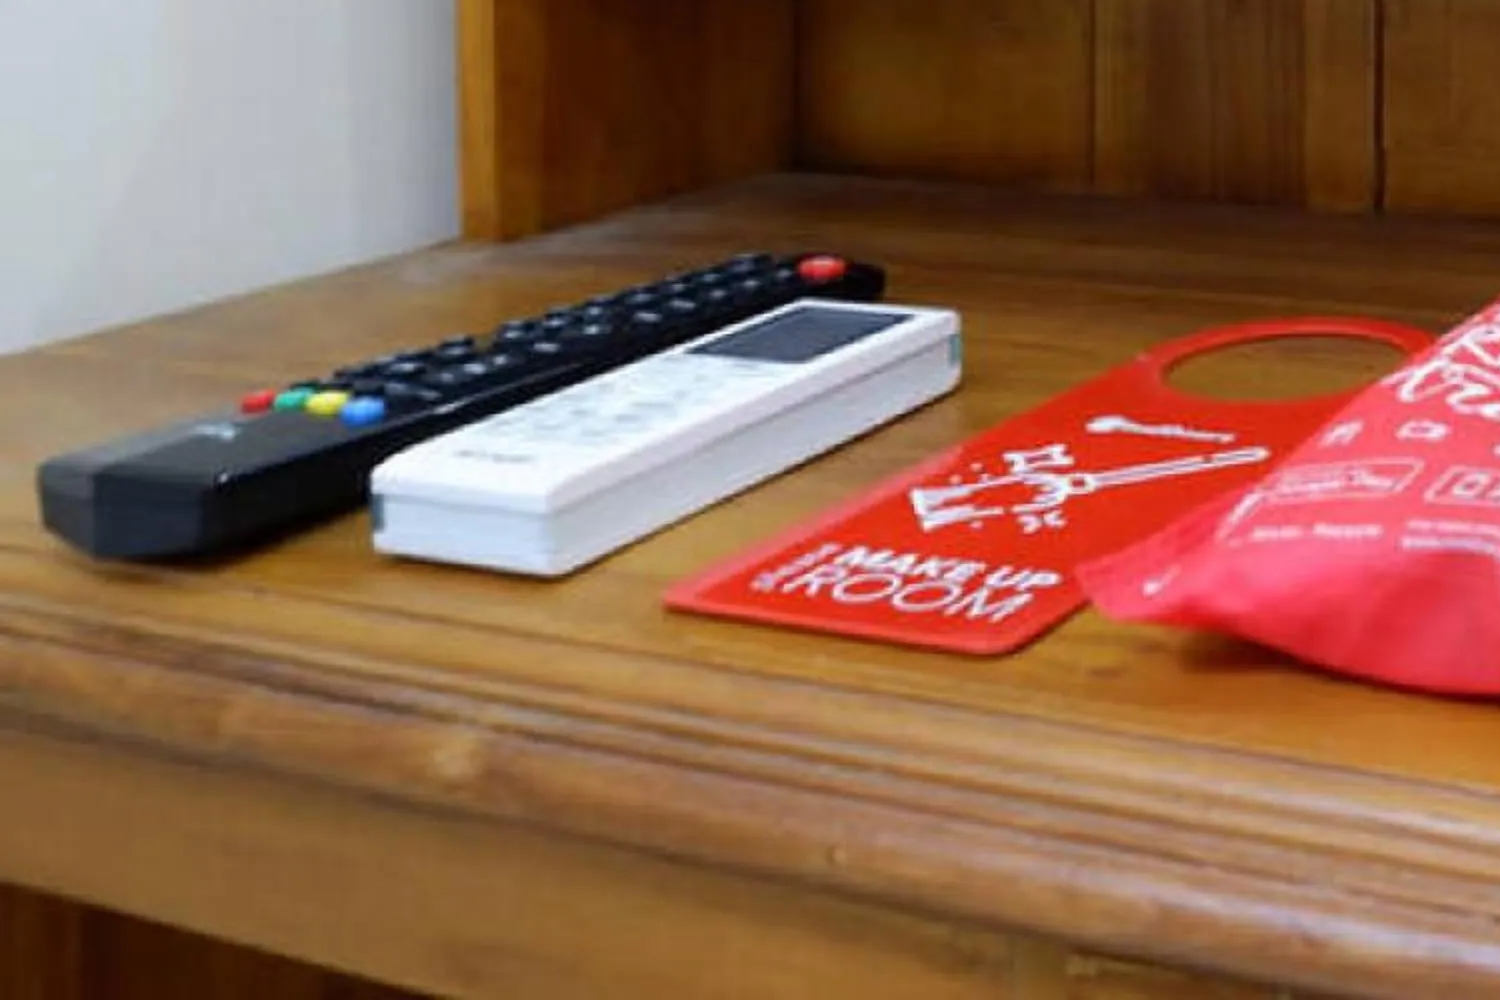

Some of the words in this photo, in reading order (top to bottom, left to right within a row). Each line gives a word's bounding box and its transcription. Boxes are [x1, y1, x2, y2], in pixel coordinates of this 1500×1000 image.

[782, 562, 1034, 623] ROOM
[833, 545, 987, 583] MAKE
[984, 565, 1061, 592] UP
